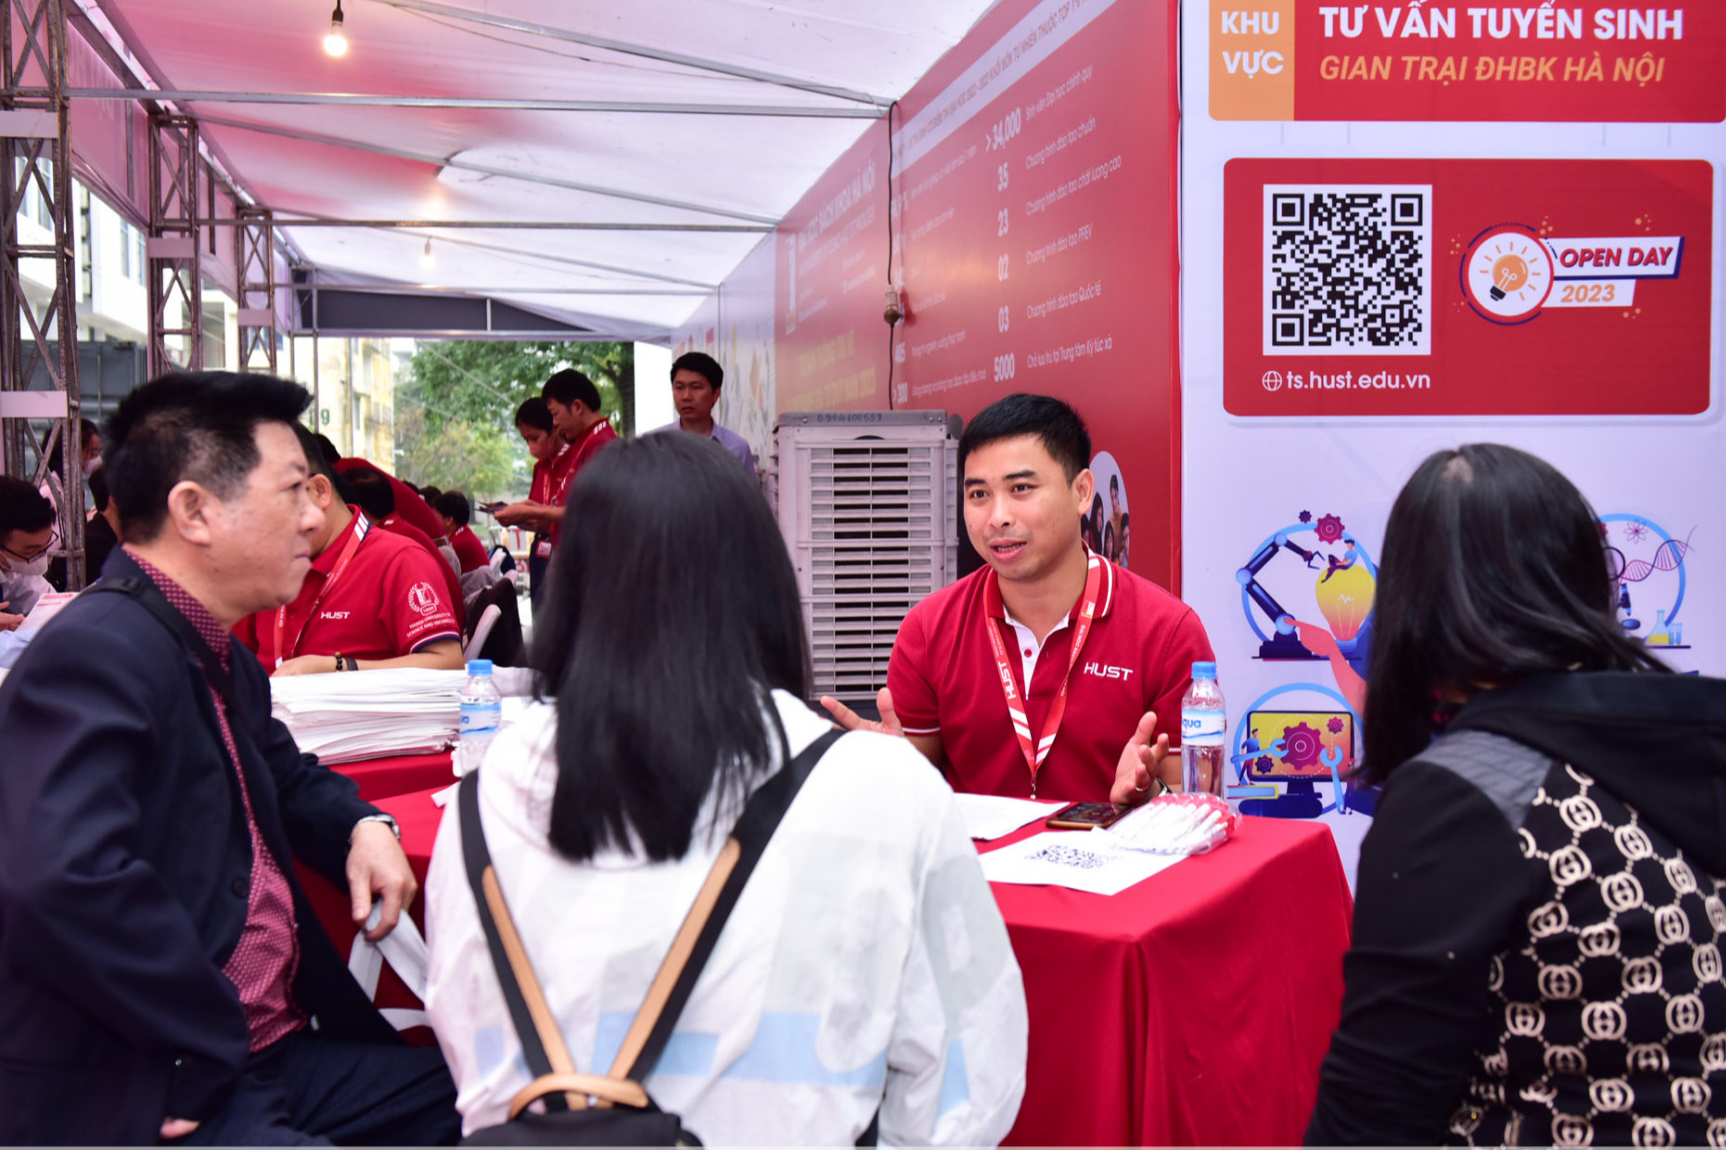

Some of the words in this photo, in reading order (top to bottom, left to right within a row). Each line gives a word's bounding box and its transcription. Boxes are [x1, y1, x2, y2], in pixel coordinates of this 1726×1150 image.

[1221, 11, 1280, 34] KHU
[1319, 5, 1369, 38] TƯ
[1374, 0, 1456, 38] VẤN
[1593, 8, 1683, 40] SINH
[1222, 49, 1284, 79] VỰC
[1319, 55, 1393, 80] GIAN
[1401, 55, 1468, 86] TRẠI
[1474, 55, 1558, 82] ĐHBK
[1563, 51, 1604, 82] HÀ
[1612, 51, 1665, 87] NỘI
[998, 161, 1009, 192] 35
[998, 207, 1009, 237] 23
[998, 253, 1009, 282] 02
[1559, 247, 1622, 268] OPEN
[1627, 246, 1674, 267] DAY
[1561, 283, 1616, 303] 2023
[998, 304, 1010, 333] 03
[993, 352, 1015, 382] 5000
[1286, 370, 1431, 389] ts.hust.edu.vn
[320, 611, 351, 620] HUST
[998, 661, 1017, 700] HUST
[1083, 661, 1134, 681] HUST
